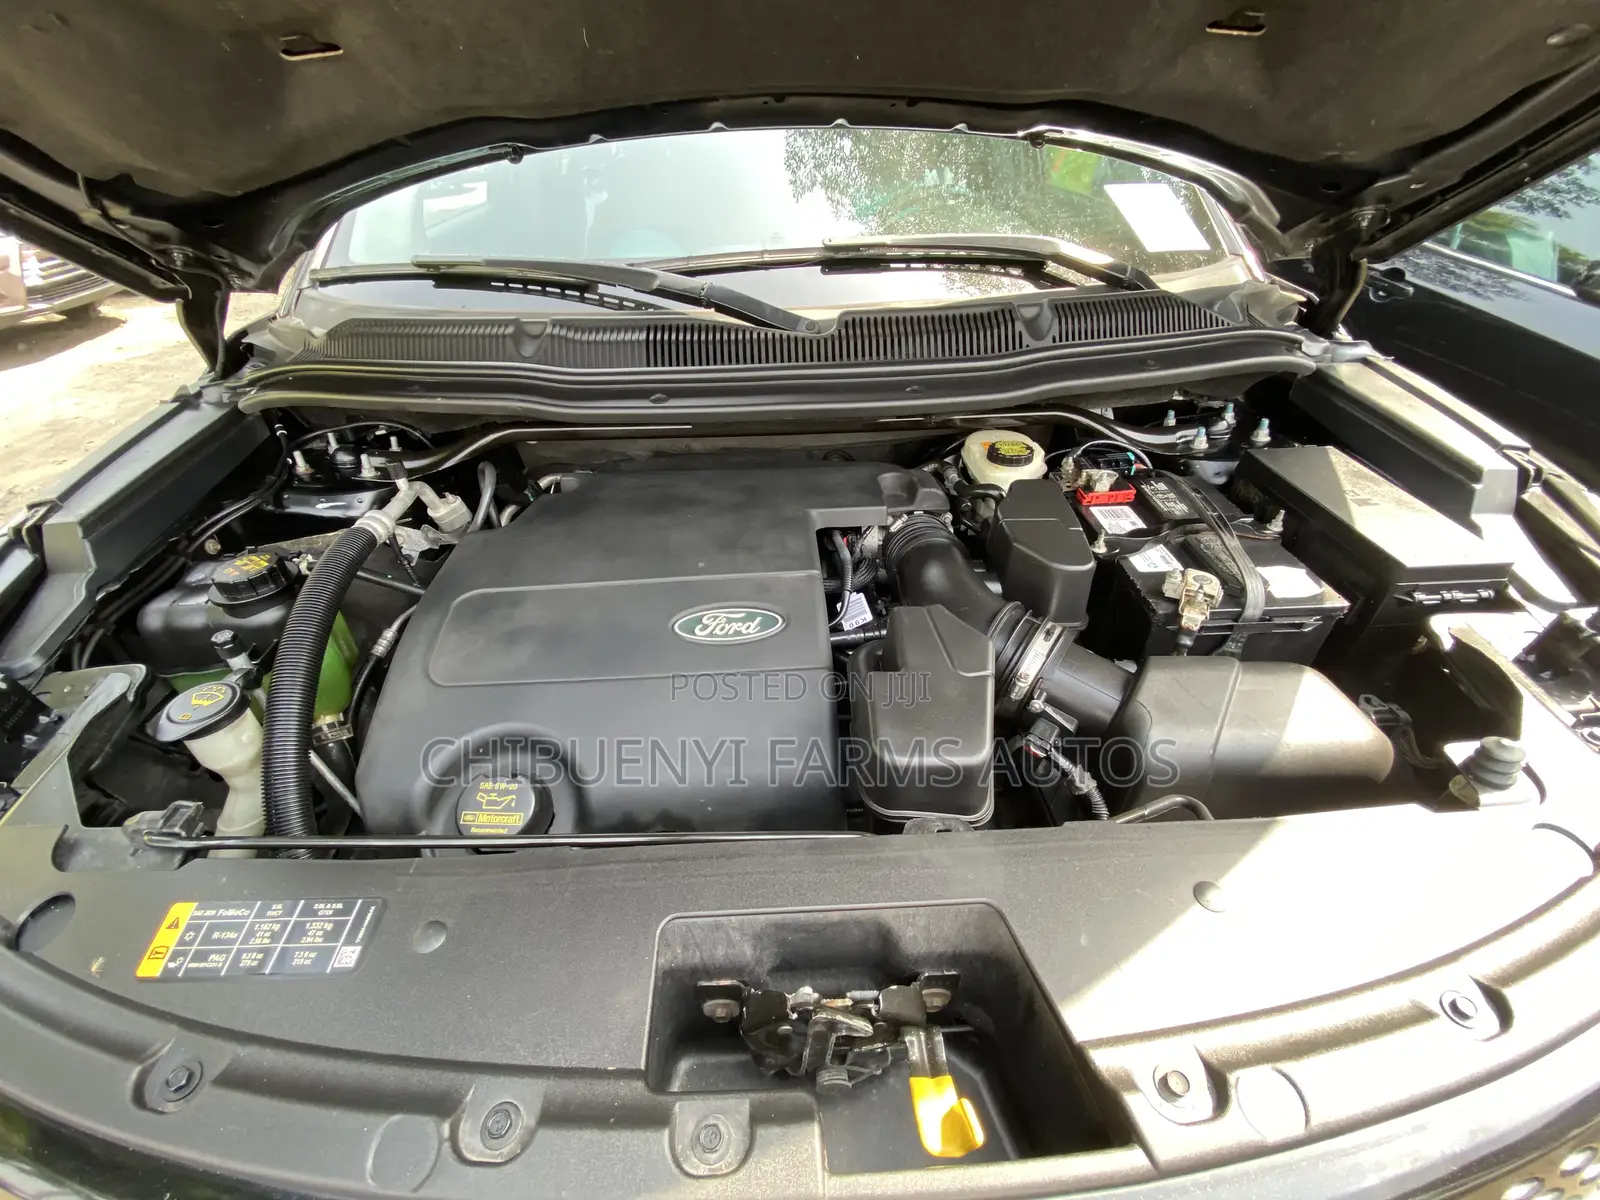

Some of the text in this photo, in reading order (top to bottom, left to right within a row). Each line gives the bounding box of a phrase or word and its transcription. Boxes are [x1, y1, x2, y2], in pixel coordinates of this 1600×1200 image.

[694, 612, 763, 636] Ford
[479, 782, 519, 790] SAE 5W-20
[477, 814, 521, 824] Motorcraft
[217, 908, 251, 917] FoMoCo
[212, 931, 239, 940] R-134a
